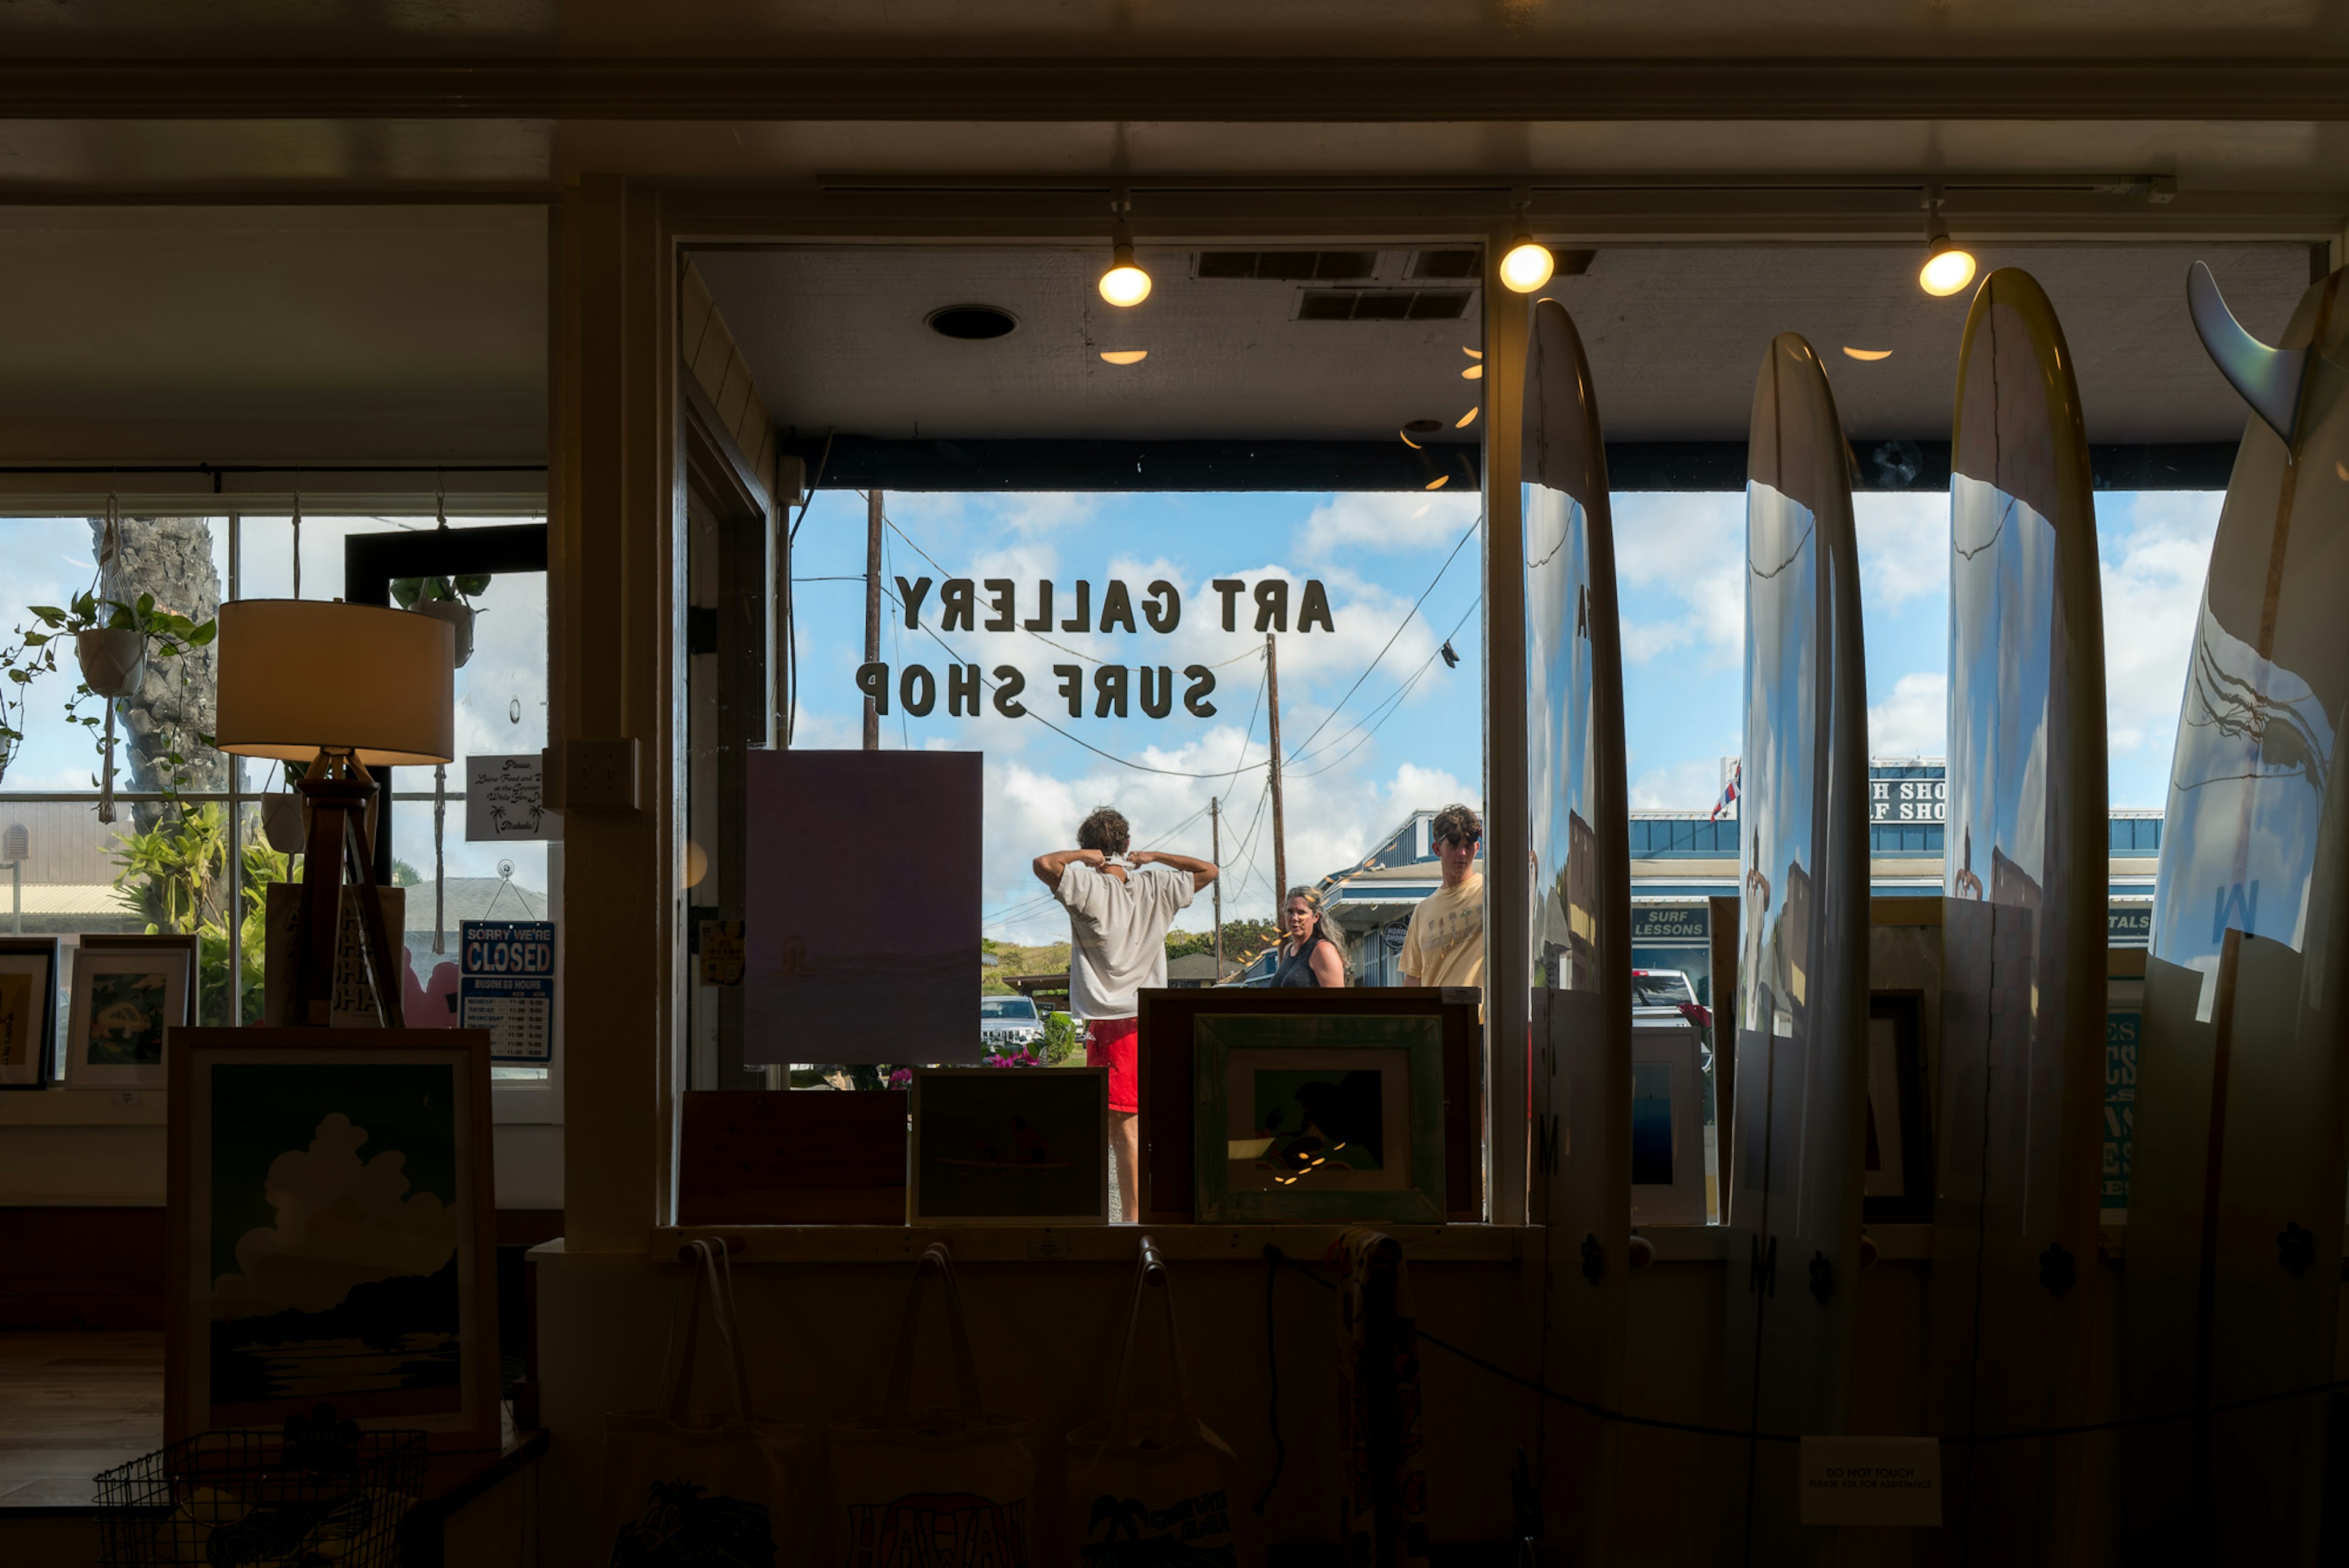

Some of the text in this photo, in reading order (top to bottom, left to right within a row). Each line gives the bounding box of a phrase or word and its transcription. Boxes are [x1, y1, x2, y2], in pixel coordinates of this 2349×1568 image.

[503, 760, 532, 770] Please,
[475, 774, 498, 784] Leave
[500, 774, 519, 782] Food
[511, 792, 527, 803] You
[500, 820, 535, 830] Mahalo!
[1649, 910, 1688, 922] SURF
[468, 929, 551, 940] SORRY WE'RE
[1635, 924, 1703, 935] LESSONS
[467, 942, 551, 972] CLOSED
[475, 979, 541, 990] BUSINESS HOURS
[1827, 1468, 1913, 1478] DO NOT TOUCH
